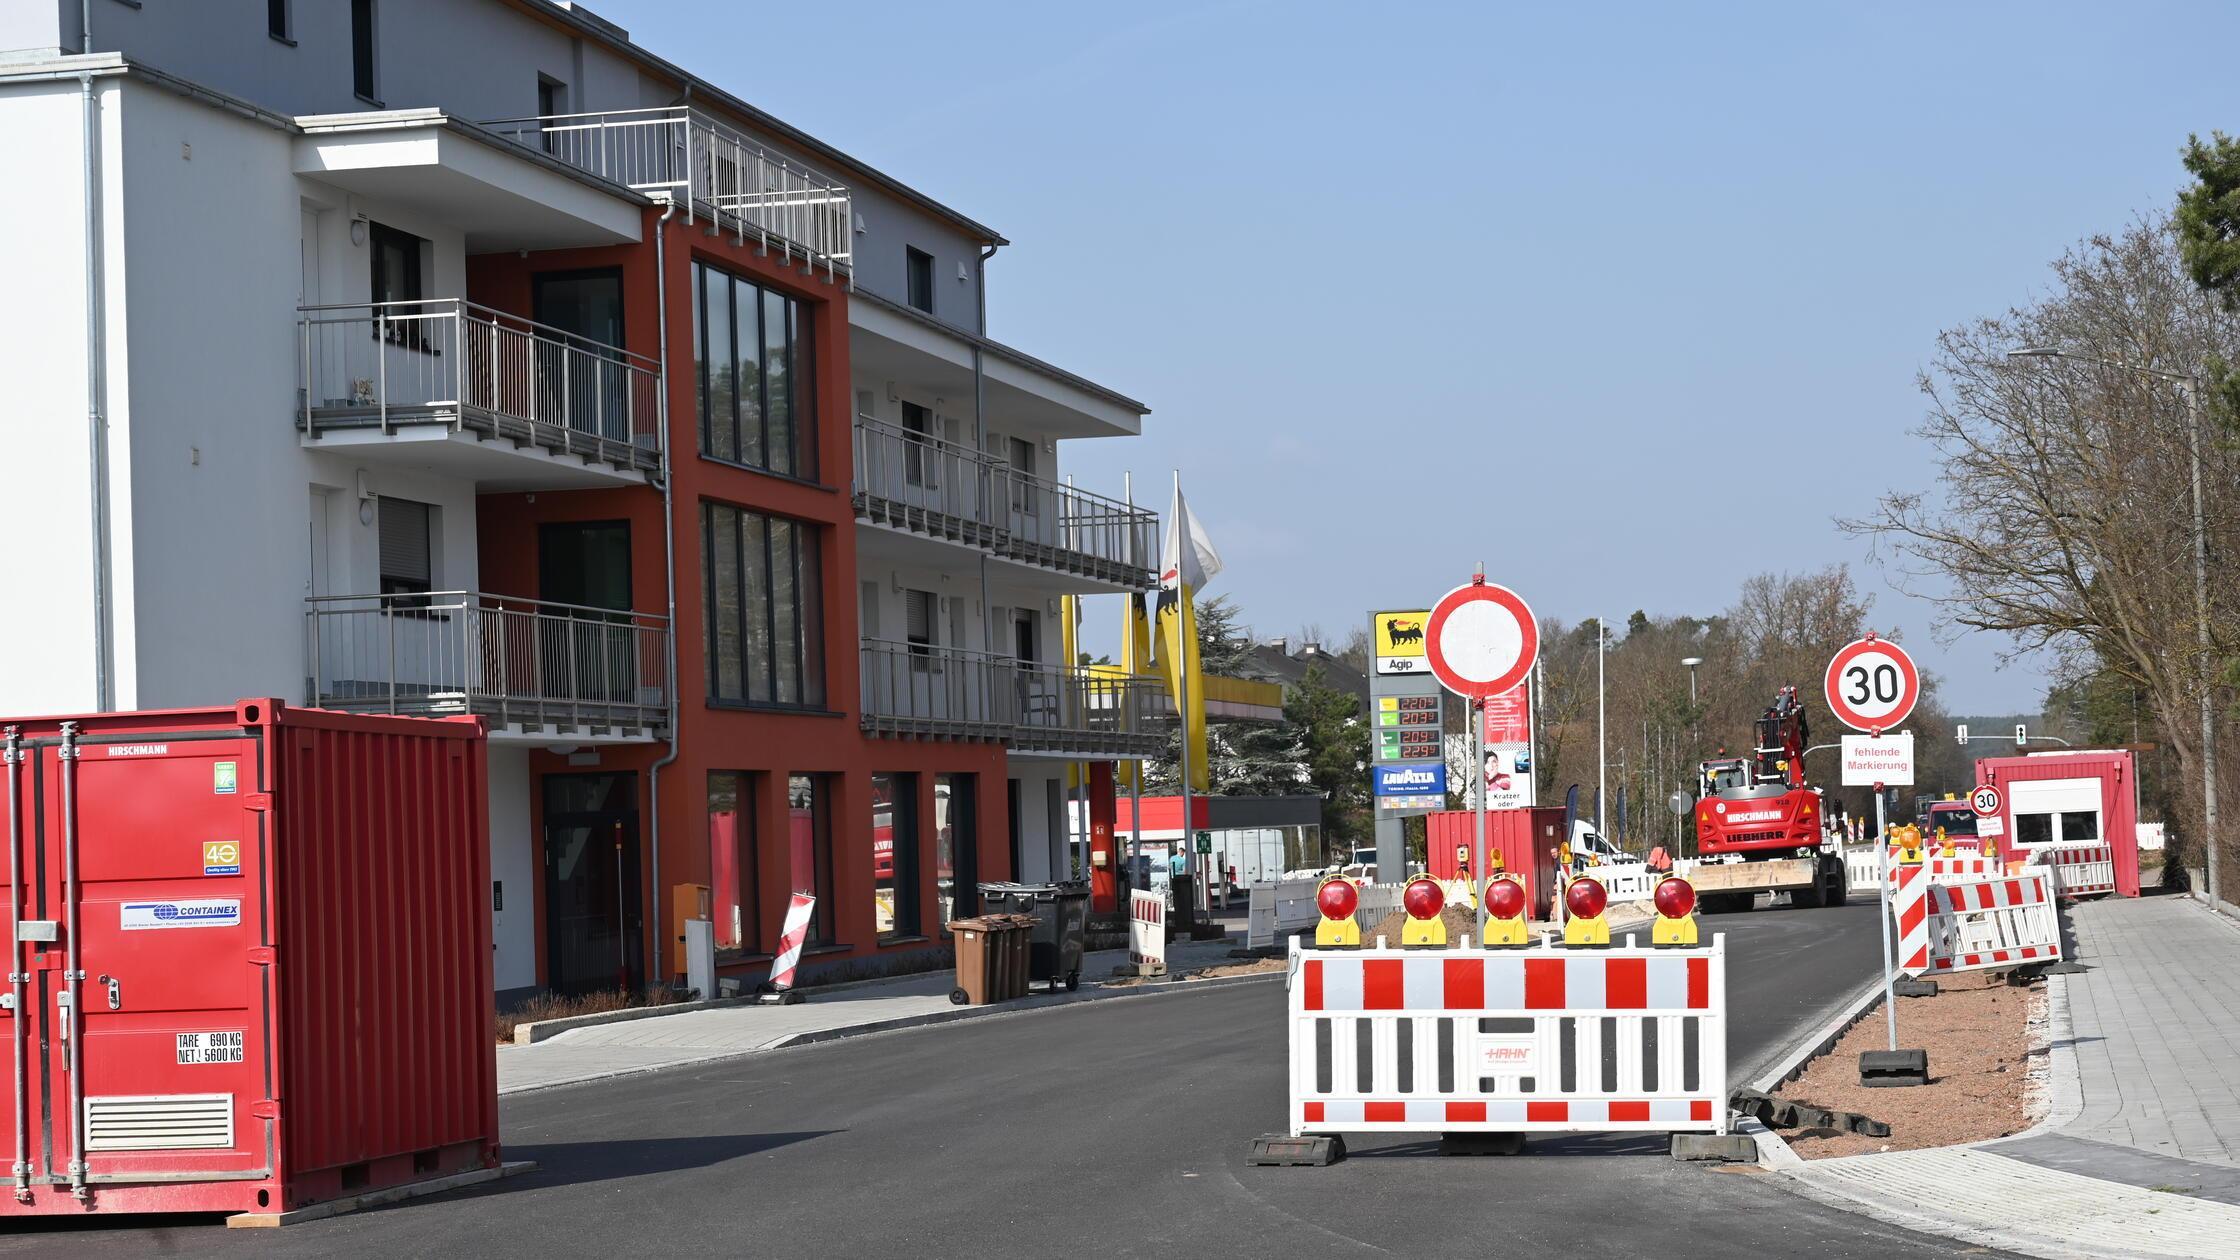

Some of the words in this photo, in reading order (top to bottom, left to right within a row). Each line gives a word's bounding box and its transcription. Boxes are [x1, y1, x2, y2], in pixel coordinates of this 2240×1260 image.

[1389, 659, 1413, 671] Agip
[1846, 664, 1898, 705] 30
[108, 744, 168, 756] HIRSCHMANN
[1854, 747, 1900, 757] fehlende
[1847, 761, 1908, 771] Markierung
[1977, 793, 1996, 808] 30
[1726, 811, 1782, 823] HIRSCHMANN
[1726, 831, 1785, 843] LIEBHERR
[180, 905, 238, 915] CONTAINEX
[178, 1034, 199, 1048] TARE
[210, 1033, 228, 1047] 690
[229, 1032, 241, 1046] KG
[205, 1048, 228, 1062] 5600
[230, 1047, 242, 1061] KG
[1485, 1048, 1531, 1059] HAHN
